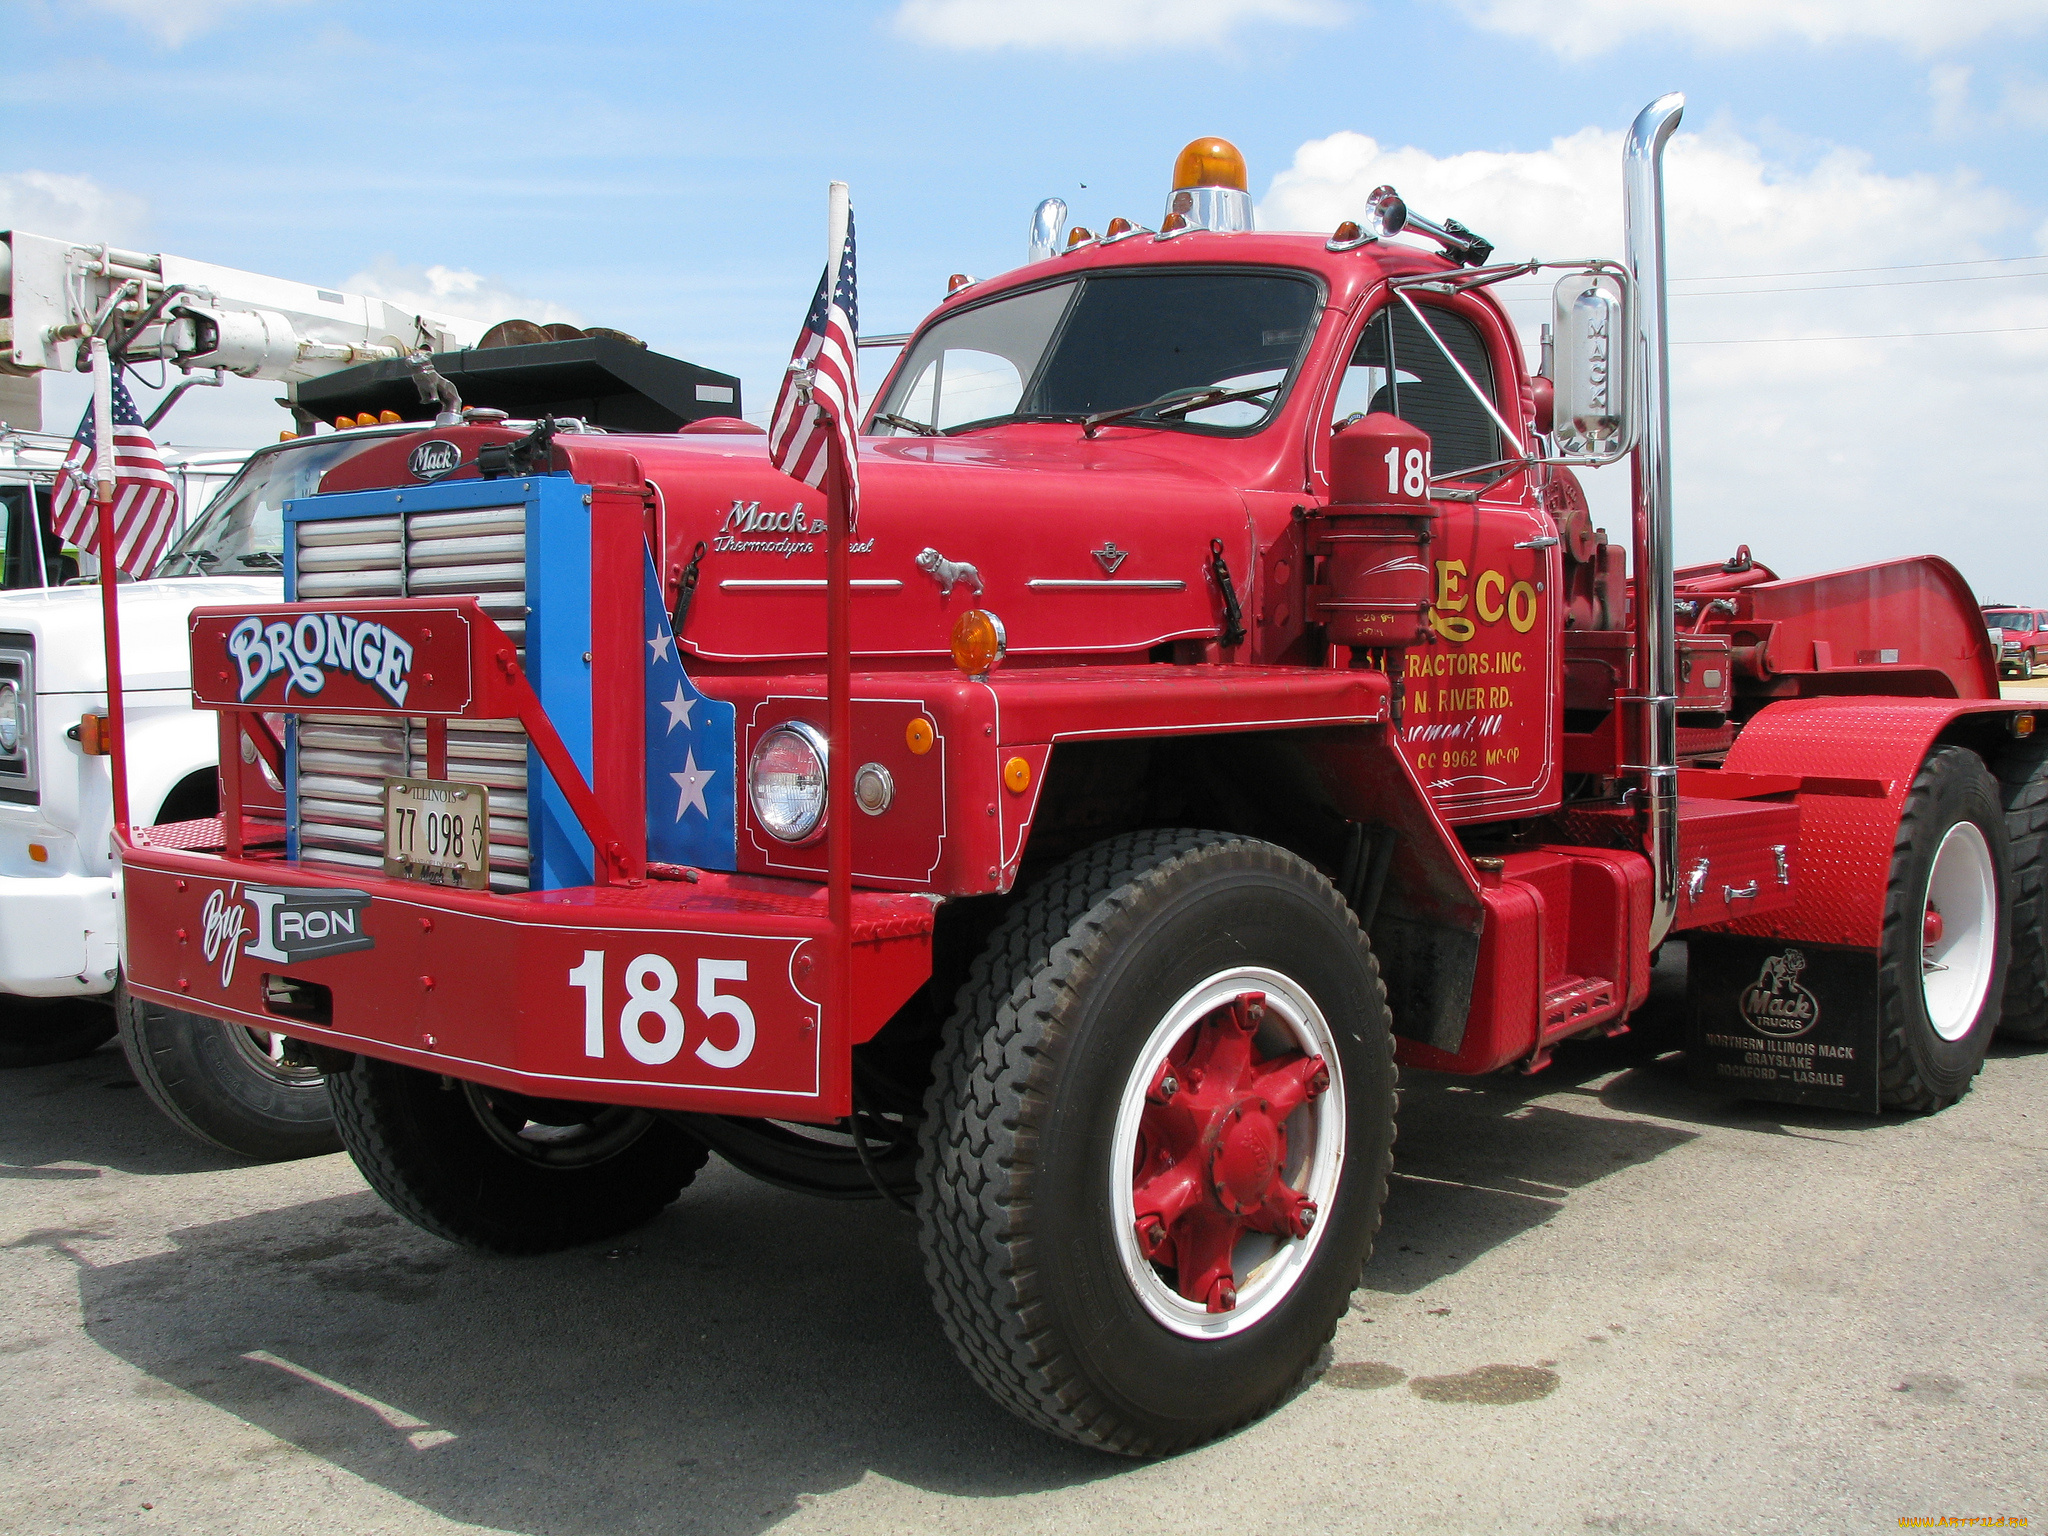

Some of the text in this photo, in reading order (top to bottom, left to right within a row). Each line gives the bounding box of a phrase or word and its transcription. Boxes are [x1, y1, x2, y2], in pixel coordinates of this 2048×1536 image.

[1587, 318, 1608, 409] MACK
[411, 445, 453, 472] Mack
[719, 500, 808, 533] Mack
[713, 535, 814, 560] Thermodyne
[1428, 559, 1537, 642] ECO
[228, 613, 414, 709] BRONGE
[1438, 687, 1486, 712] RIVER
[1489, 685, 1514, 709] RD.
[1417, 752, 1437, 769] CC
[1442, 749, 1478, 768] 9962
[412, 787, 457, 803] ILLINOIS
[396, 807, 417, 851] 77
[428, 811, 464, 858] 098
[202, 881, 356, 988] Big IRON
[568, 949, 757, 1070] 185
[1747, 989, 1812, 1018] Mack
[1756, 1016, 1802, 1029] TRUCKS
[1706, 1034, 1853, 1059] NORTHERN ILLINOIS MACK
[1745, 1052, 1812, 1069] GRAYSLAKE
[1718, 1064, 1776, 1079] ROCKFORD
[1793, 1069, 1844, 1087] LASALLE
